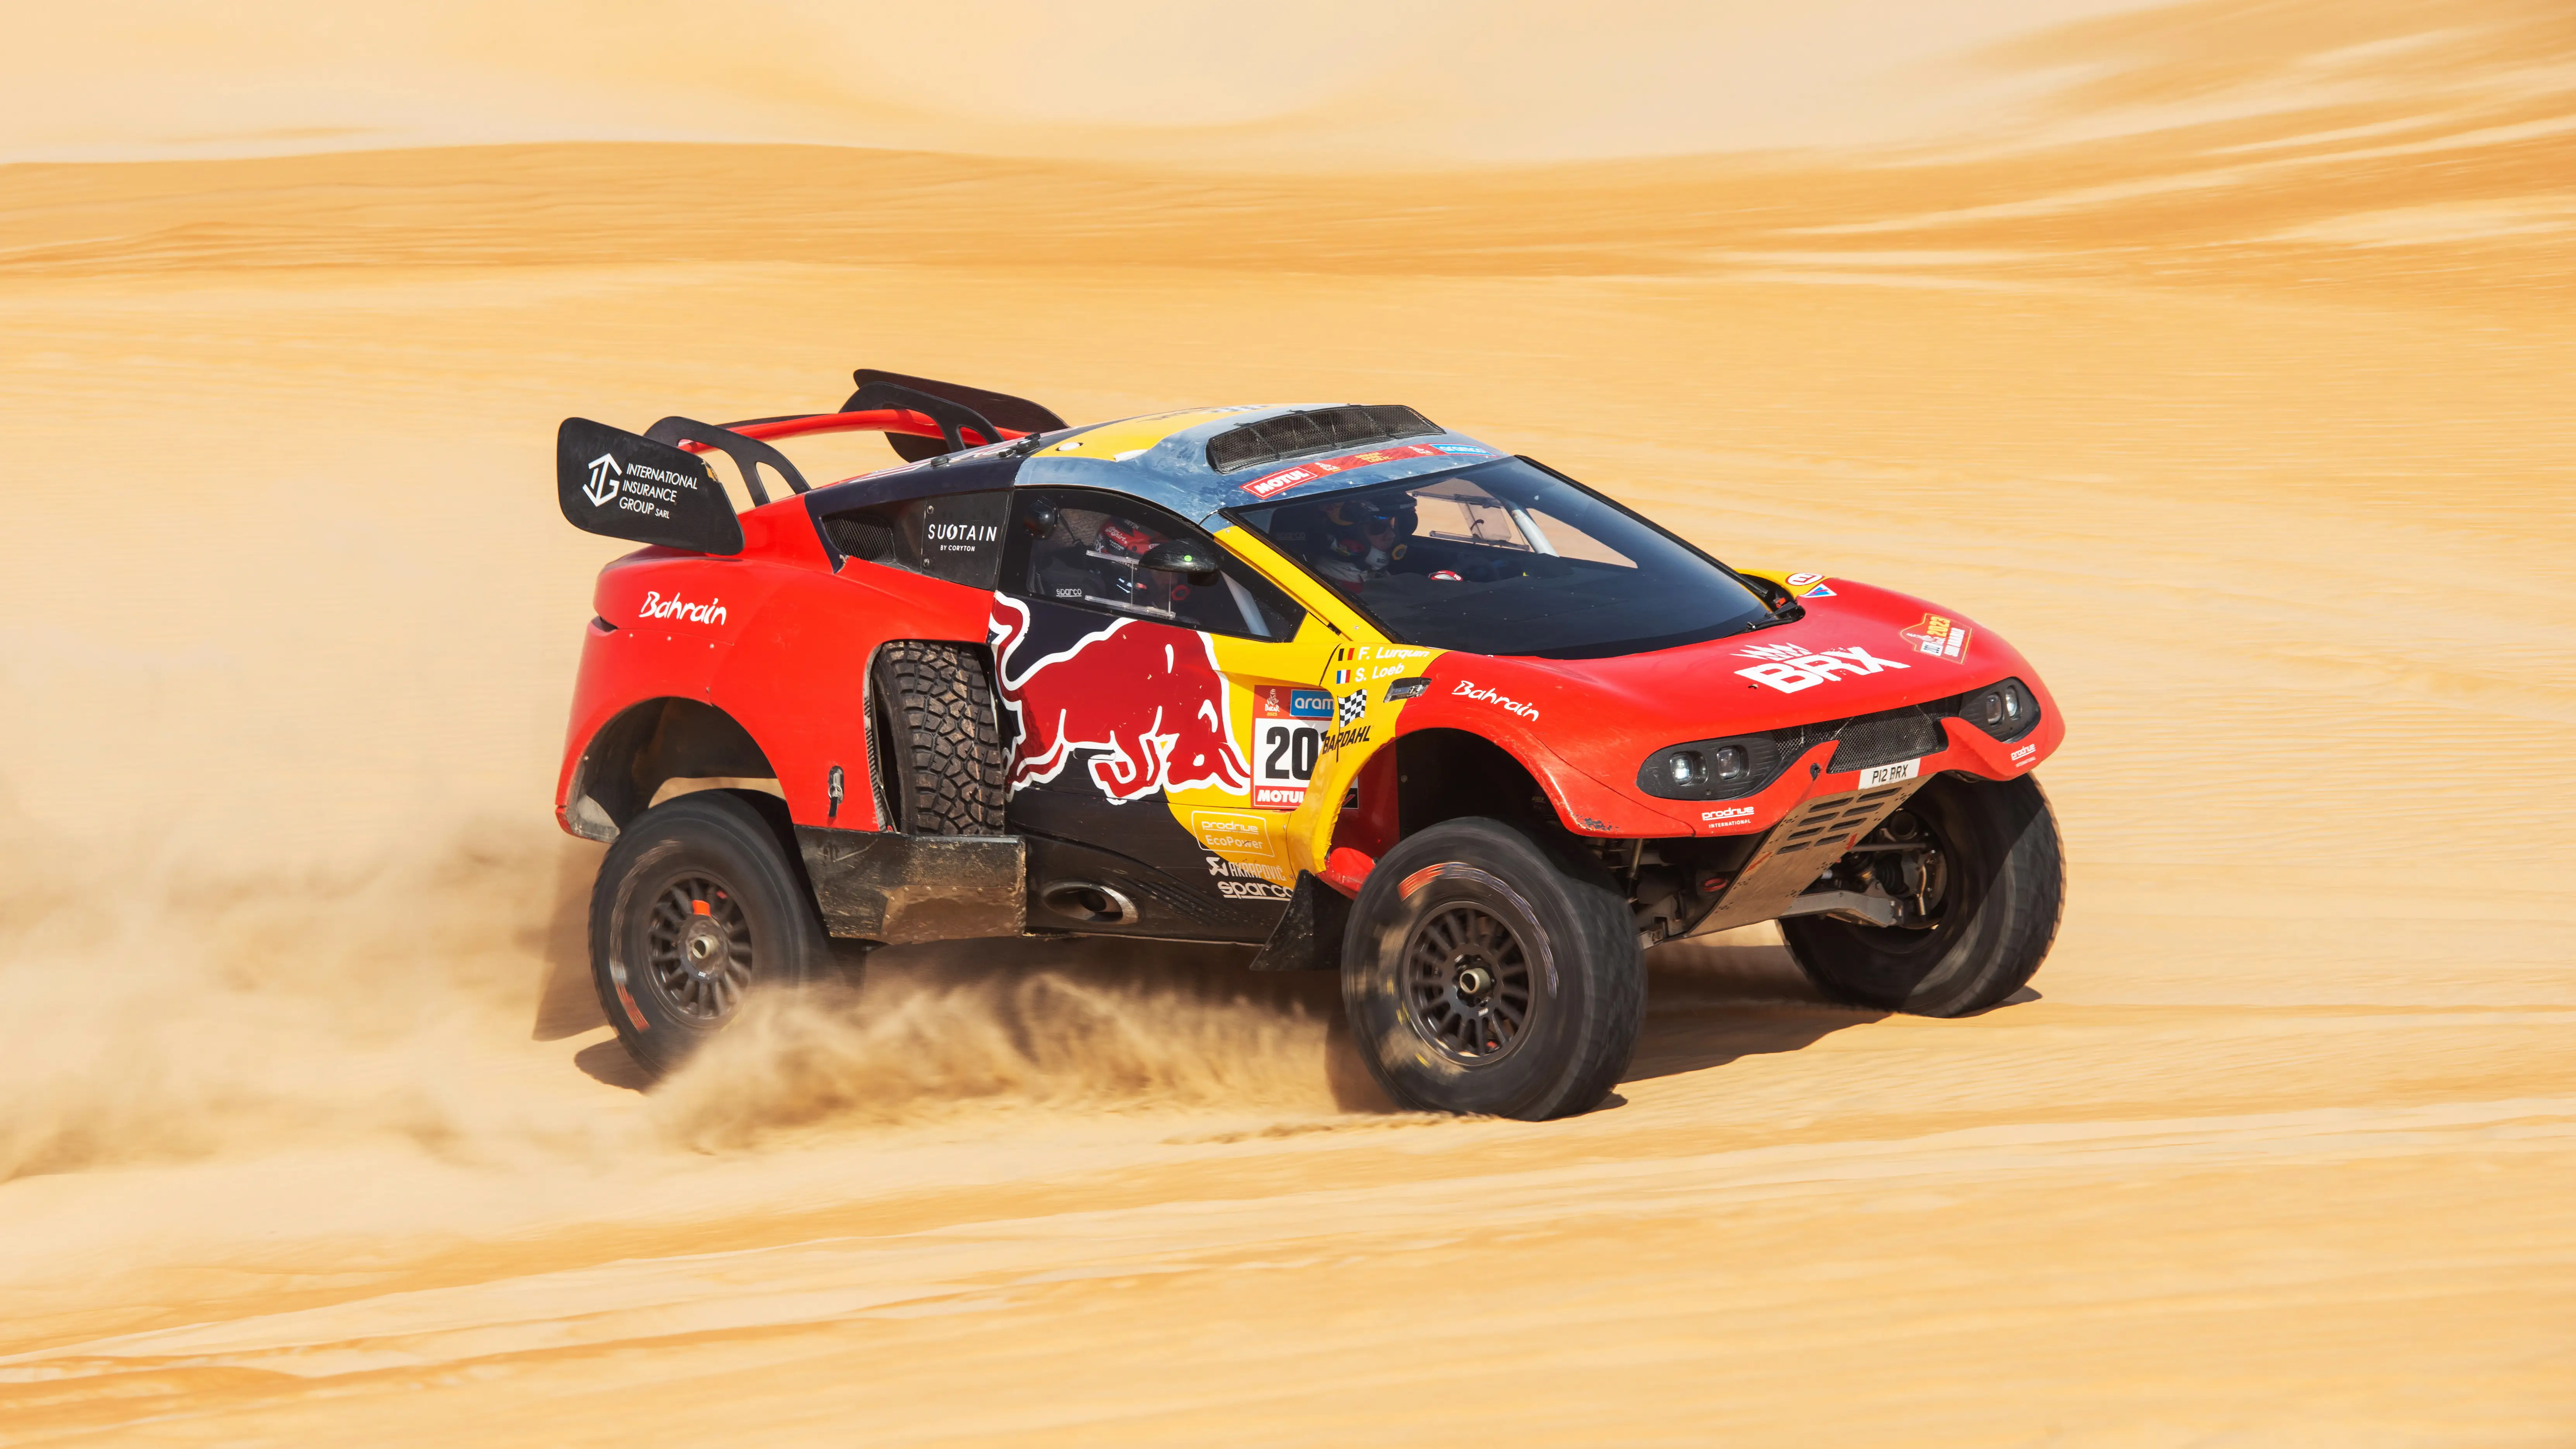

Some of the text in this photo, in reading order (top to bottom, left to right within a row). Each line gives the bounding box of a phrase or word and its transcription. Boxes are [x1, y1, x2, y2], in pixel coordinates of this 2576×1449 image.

[626, 462, 697, 490] INTERNATIONAL
[1254, 470, 1310, 494] MOTUL
[622, 480, 677, 502] INSURANCE
[619, 497, 669, 519] GROUP SARL
[1056, 588, 1082, 597] sparco
[639, 591, 727, 625] Bahrain
[1927, 616, 1950, 637] 2023
[1358, 647, 1430, 660] F. Lurquin
[1355, 663, 1405, 682] S. Loeb
[1734, 646, 1911, 693] BRX
[1265, 704, 1280, 712] DAKAR
[1295, 698, 1334, 710] aram
[1451, 680, 1539, 721] Bahrain
[1322, 725, 1371, 755] BARDAHL
[1266, 727, 1328, 780] 20
[1872, 769, 1888, 784] P12
[1702, 806, 1754, 821] prodrive
[1708, 819, 1751, 828] INTERNATIONAL
[1202, 821, 1259, 834] prodrive
[1205, 835, 1263, 849] EcoPower
[1217, 881, 1294, 901] sparco
